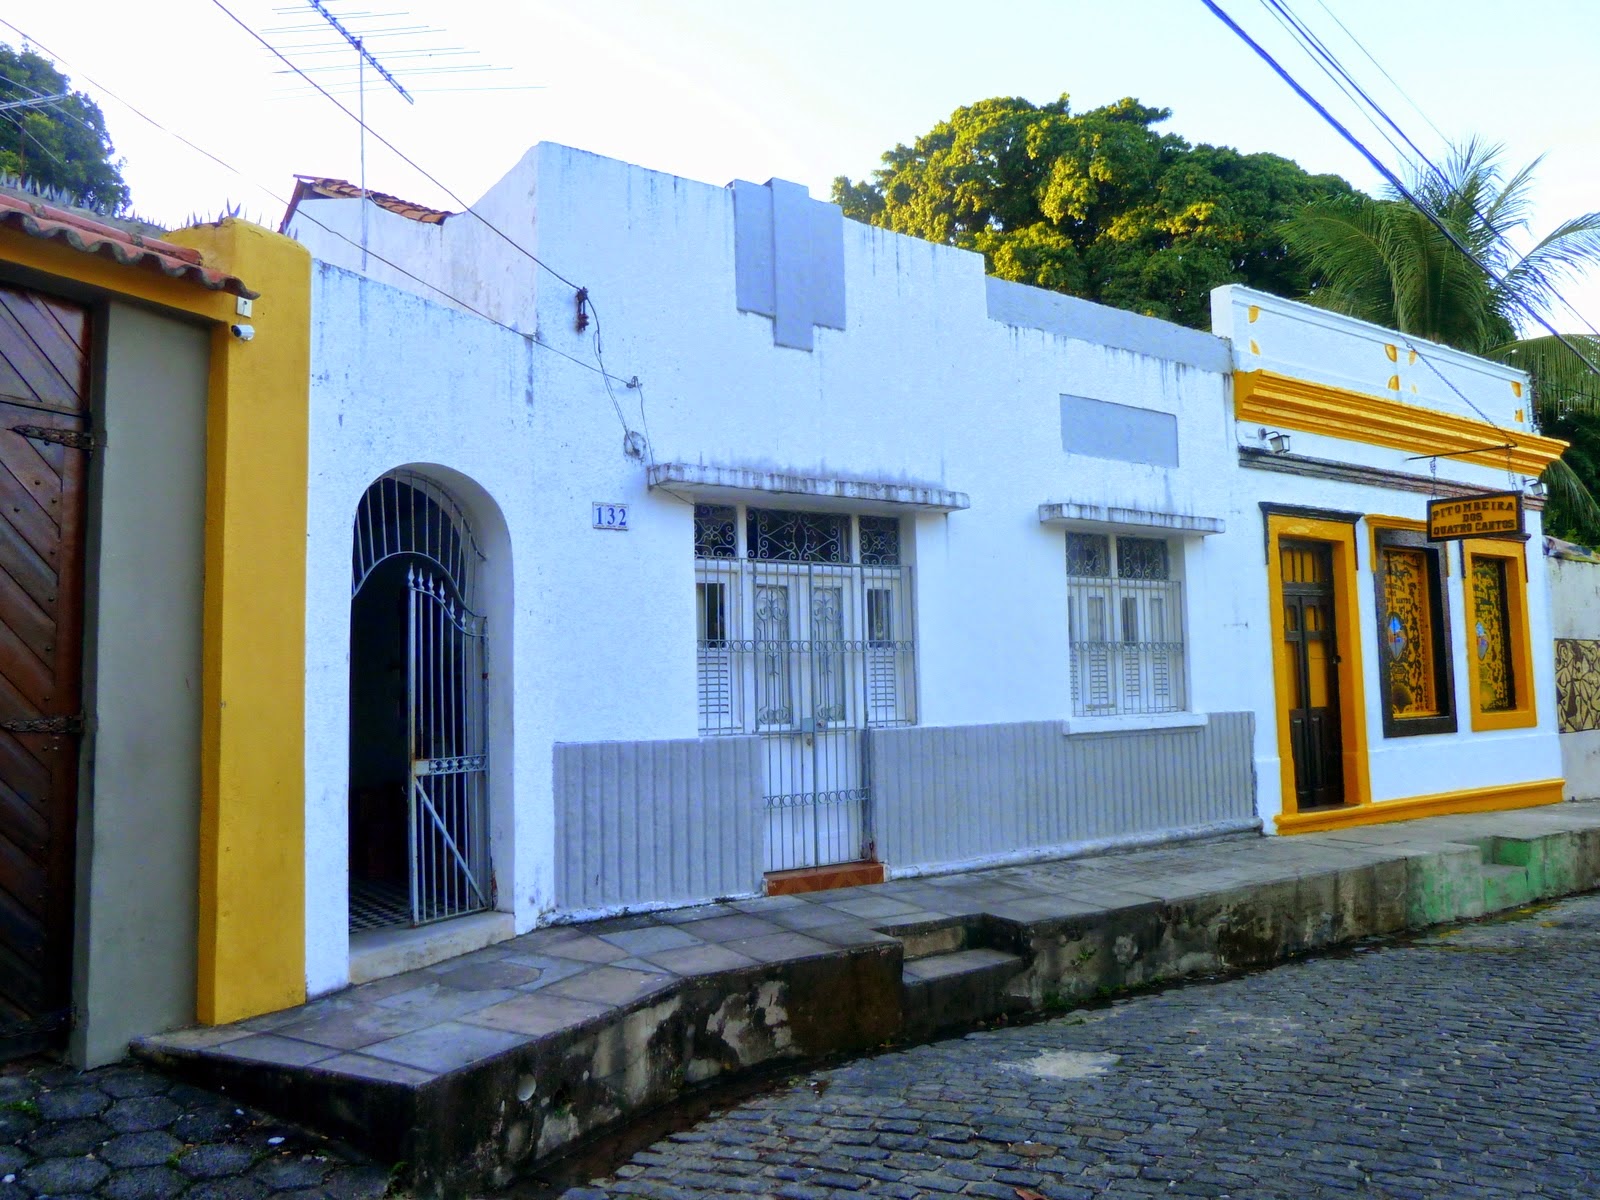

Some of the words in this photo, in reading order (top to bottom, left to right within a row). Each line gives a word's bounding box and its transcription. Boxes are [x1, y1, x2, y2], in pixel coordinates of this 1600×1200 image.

[596, 506, 627, 526] 132
[1432, 501, 1514, 520] PITOMBEIRA
[1462, 512, 1483, 522] DOS
[1433, 523, 1472, 535] QUATRO
[1475, 519, 1515, 531] CANTOS
